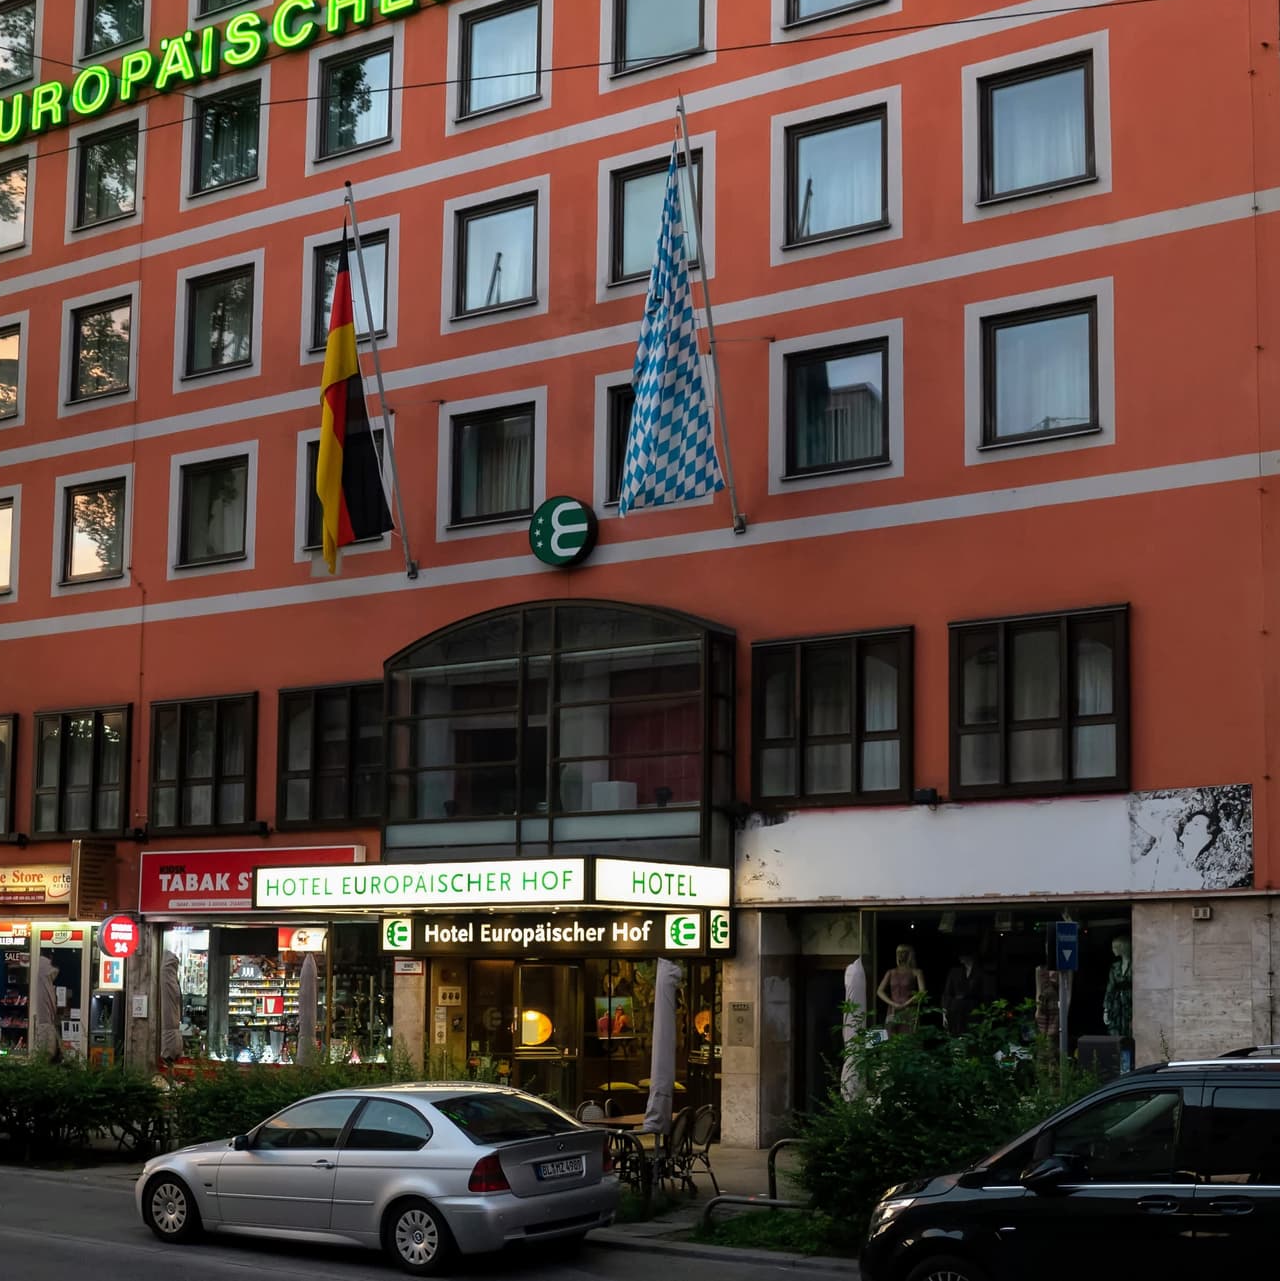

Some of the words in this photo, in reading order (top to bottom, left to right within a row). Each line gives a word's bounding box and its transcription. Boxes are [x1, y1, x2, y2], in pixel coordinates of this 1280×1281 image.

[12, 870, 43, 883] Store
[53, 873, 71, 883] orte
[159, 872, 231, 892] TABAK
[266, 877, 333, 896] HOTEL
[342, 870, 511, 895] EUROPÄISCHER
[522, 870, 573, 891] HOF
[632, 871, 697, 897] HOTEL
[424, 924, 473, 943] Hotel
[480, 921, 605, 947] Europäischer
[612, 920, 653, 942] Hof
[5, 952, 19, 961] SALE
